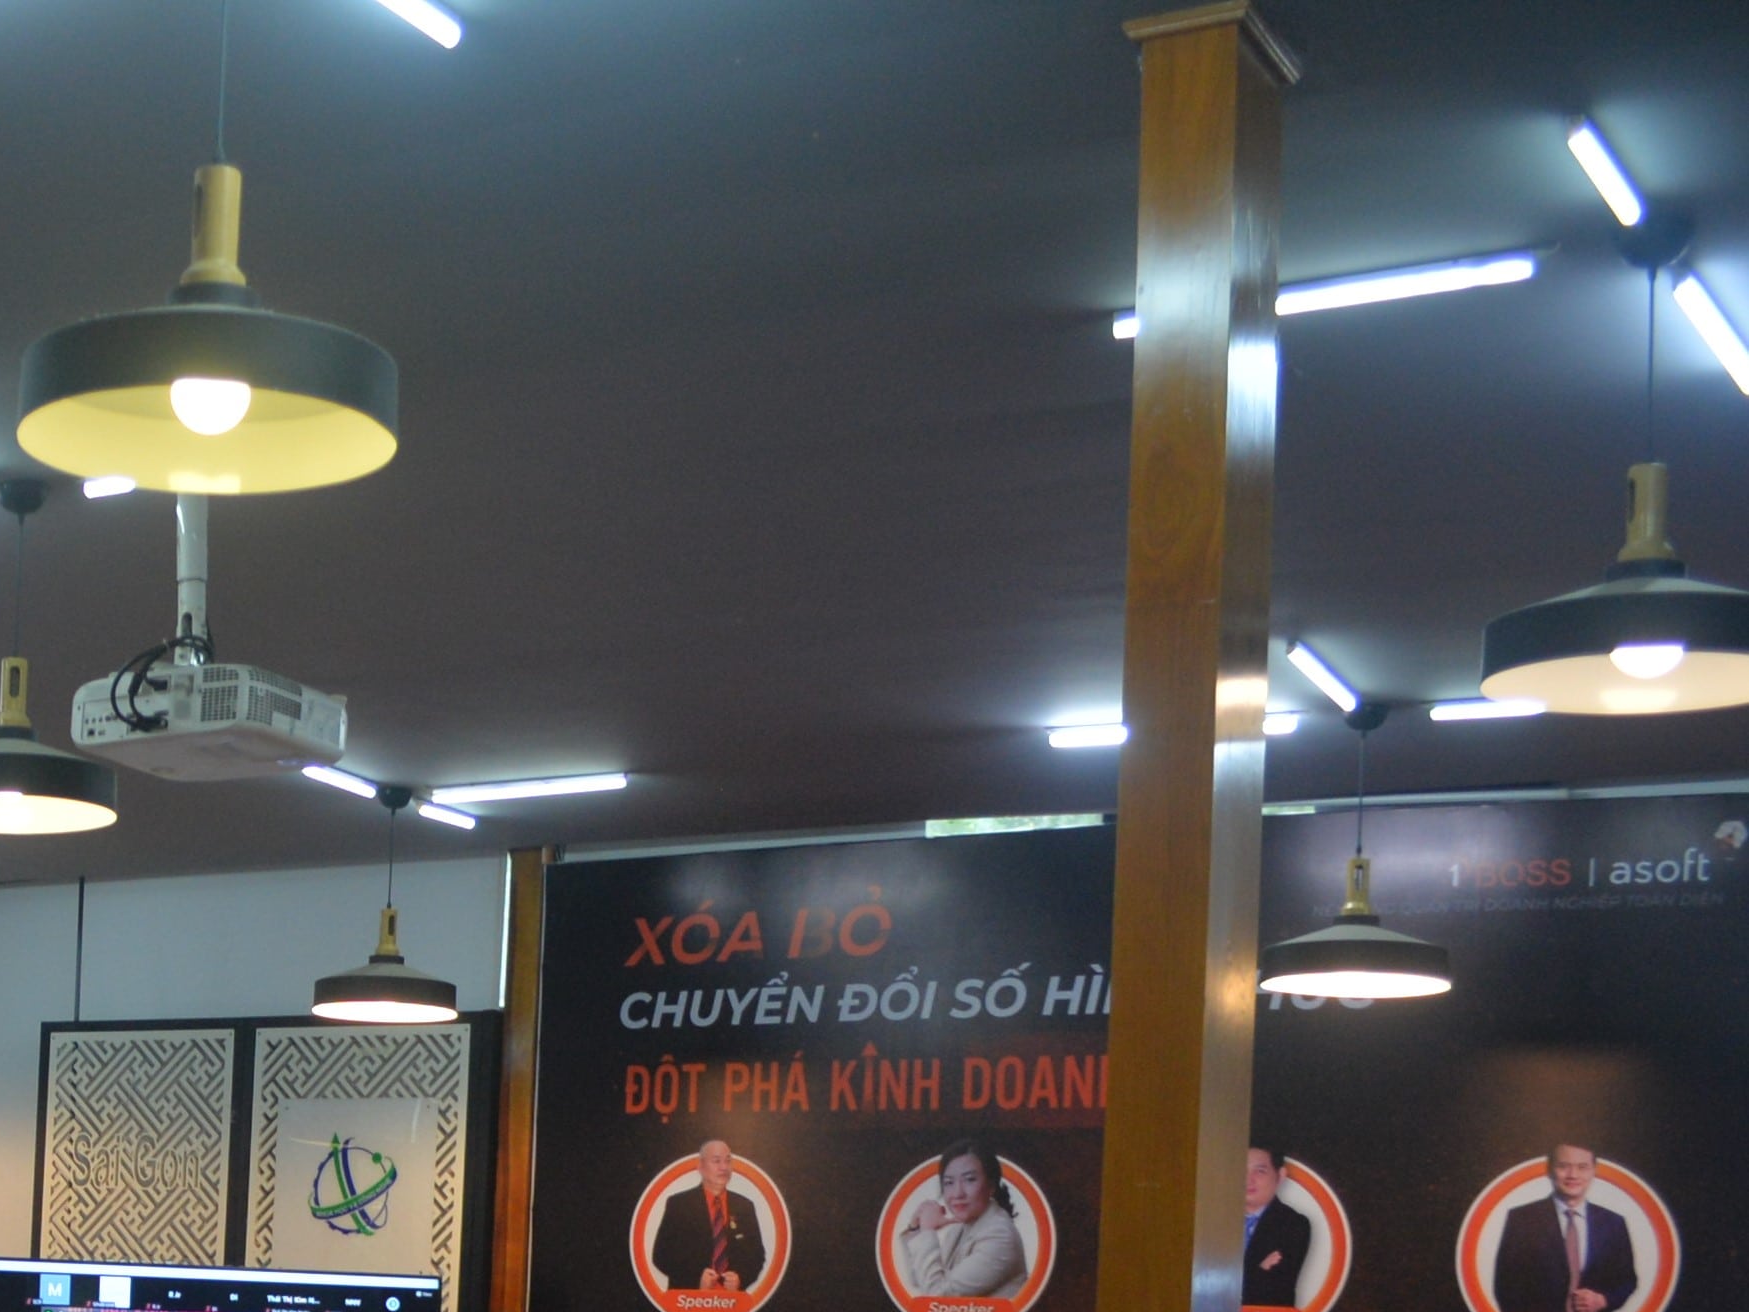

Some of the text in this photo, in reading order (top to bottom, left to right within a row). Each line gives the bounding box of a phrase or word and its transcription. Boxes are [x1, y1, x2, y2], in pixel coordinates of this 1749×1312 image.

[1609, 848, 1712, 885] asoft
[623, 884, 894, 968] XÓA BỎ
[620, 961, 1111, 1030] CHUYỂN ĐỔI SỐ HÌ
[624, 1042, 1108, 1125] ĐỘT PHÁ KINH DOAN
[676, 1295, 736, 1310] Speaker
